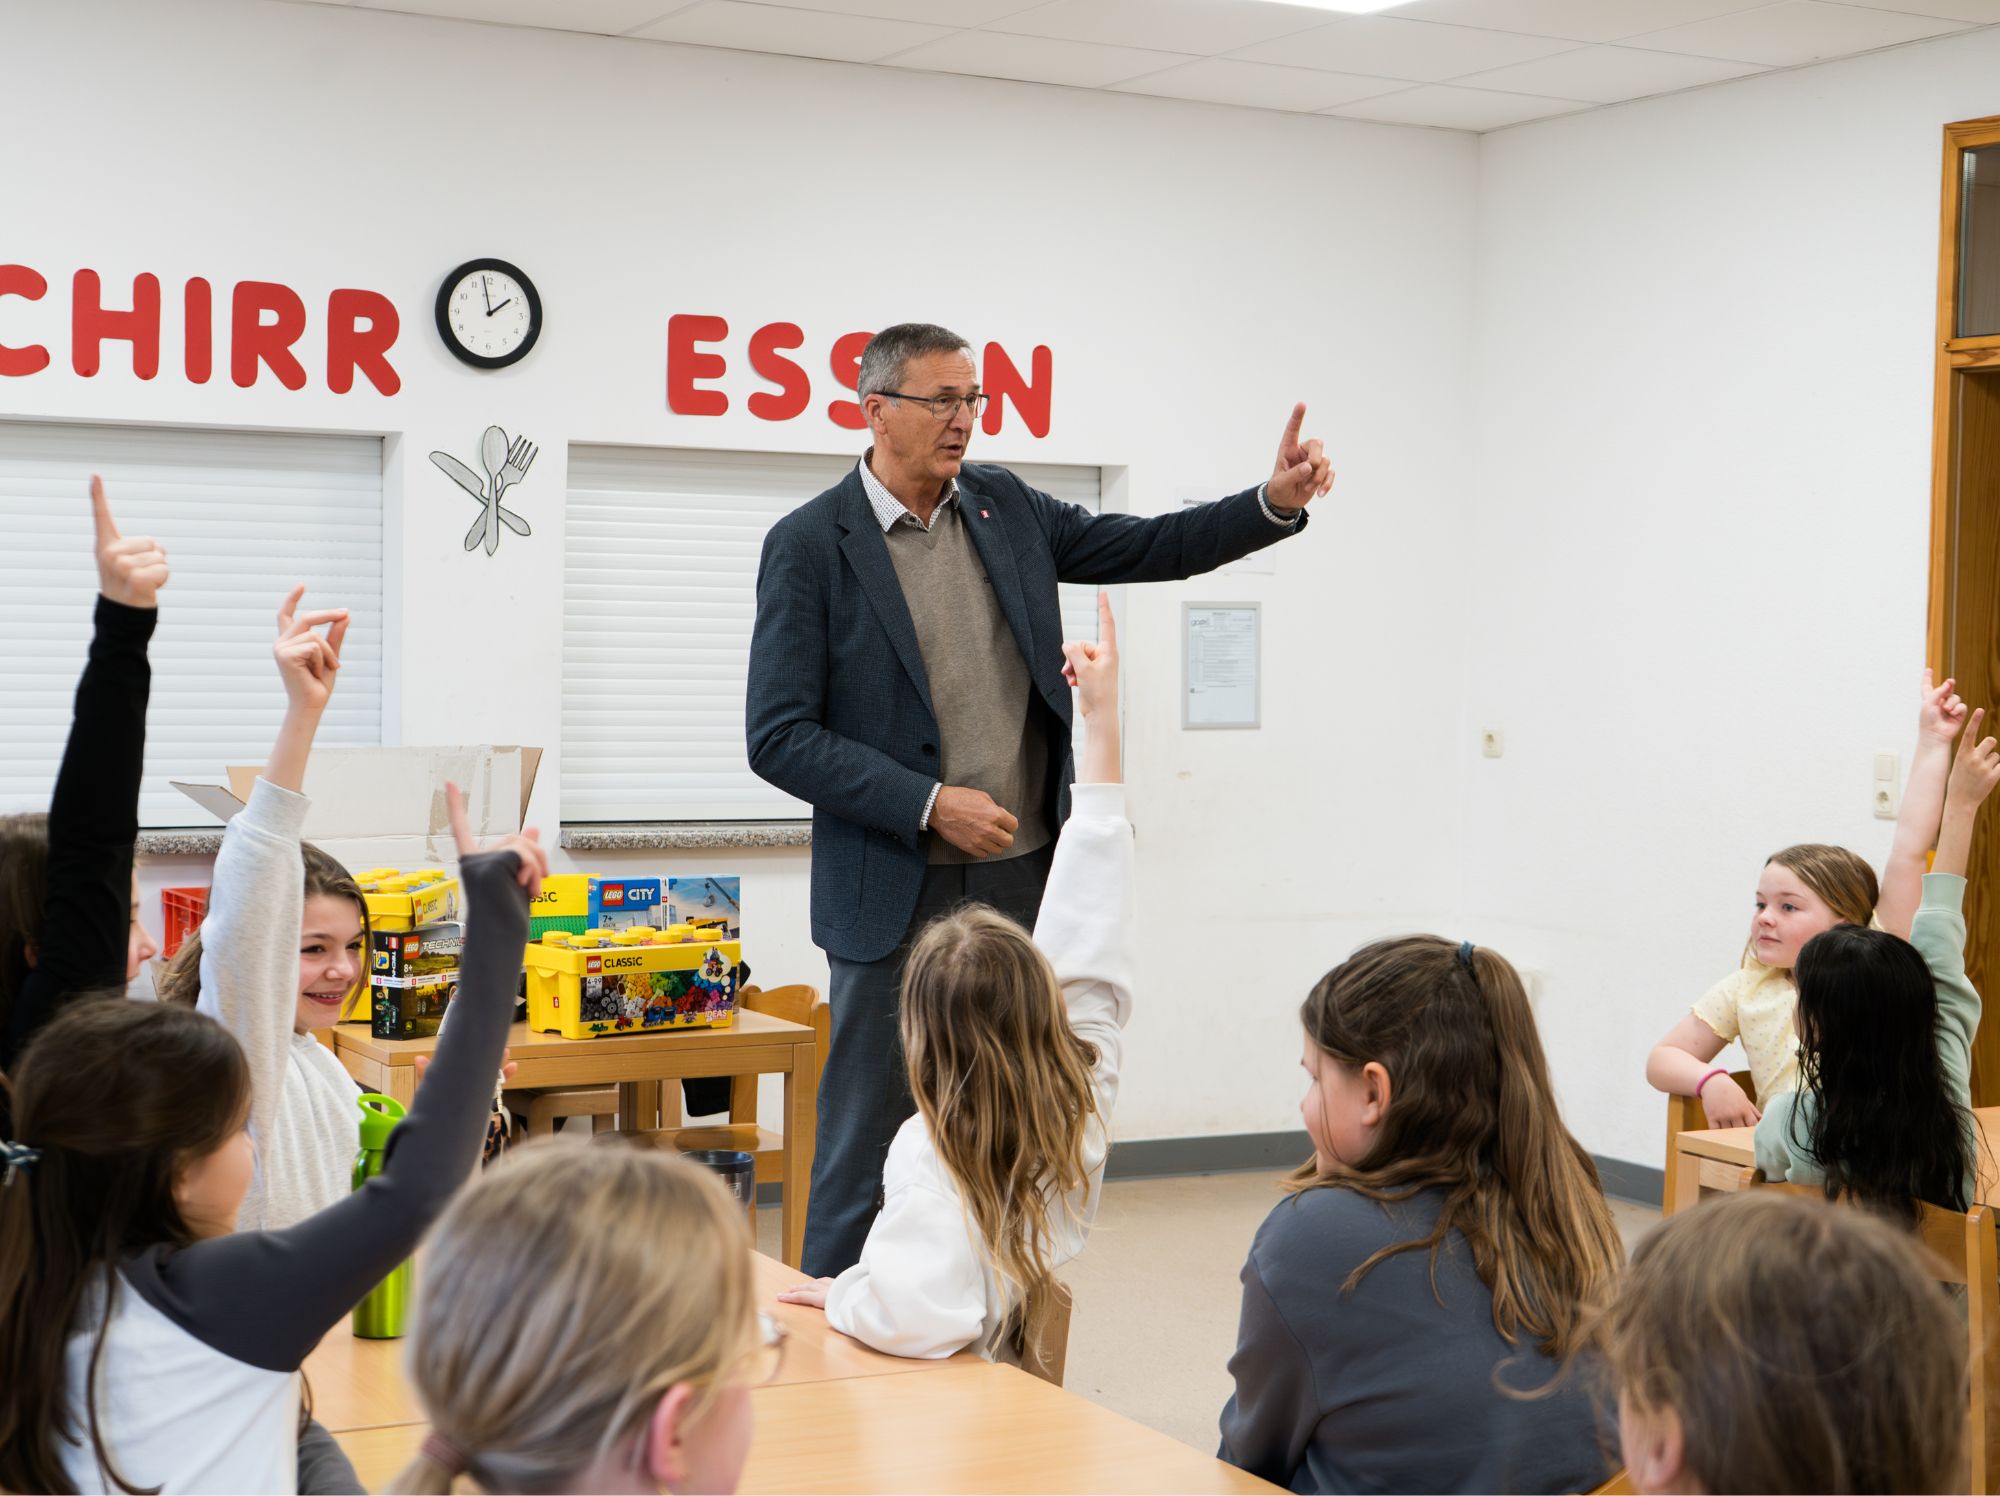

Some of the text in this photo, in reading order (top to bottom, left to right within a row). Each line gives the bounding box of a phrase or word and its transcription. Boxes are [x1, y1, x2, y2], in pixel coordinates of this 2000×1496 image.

[667, 314, 1052, 439] ESSN
[604, 889, 623, 900] LEGO
[602, 914, 613, 923] 7+
[405, 943, 418, 953] LEGO
[403, 963, 413, 973] 8+
[587, 960, 601, 968] LEGO
